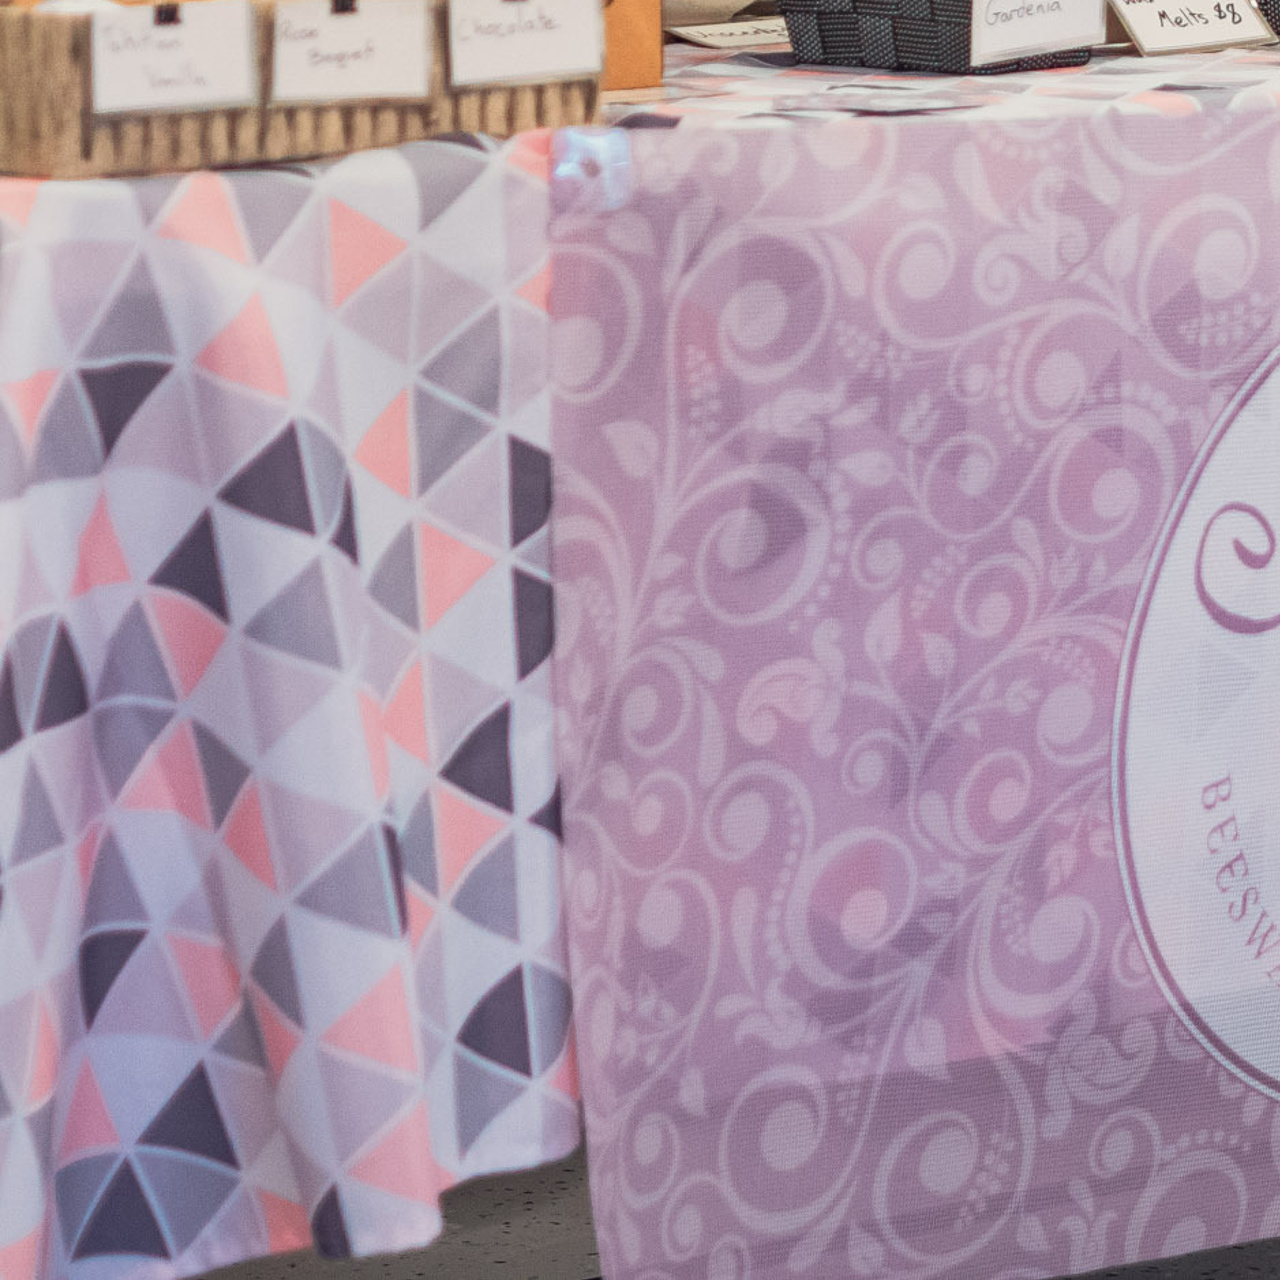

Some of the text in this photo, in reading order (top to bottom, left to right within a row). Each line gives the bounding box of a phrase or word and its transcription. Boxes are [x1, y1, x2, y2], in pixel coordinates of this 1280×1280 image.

[457, 7, 561, 42] Chocolate
[1158, 1, 1243, 29] Melts $8
